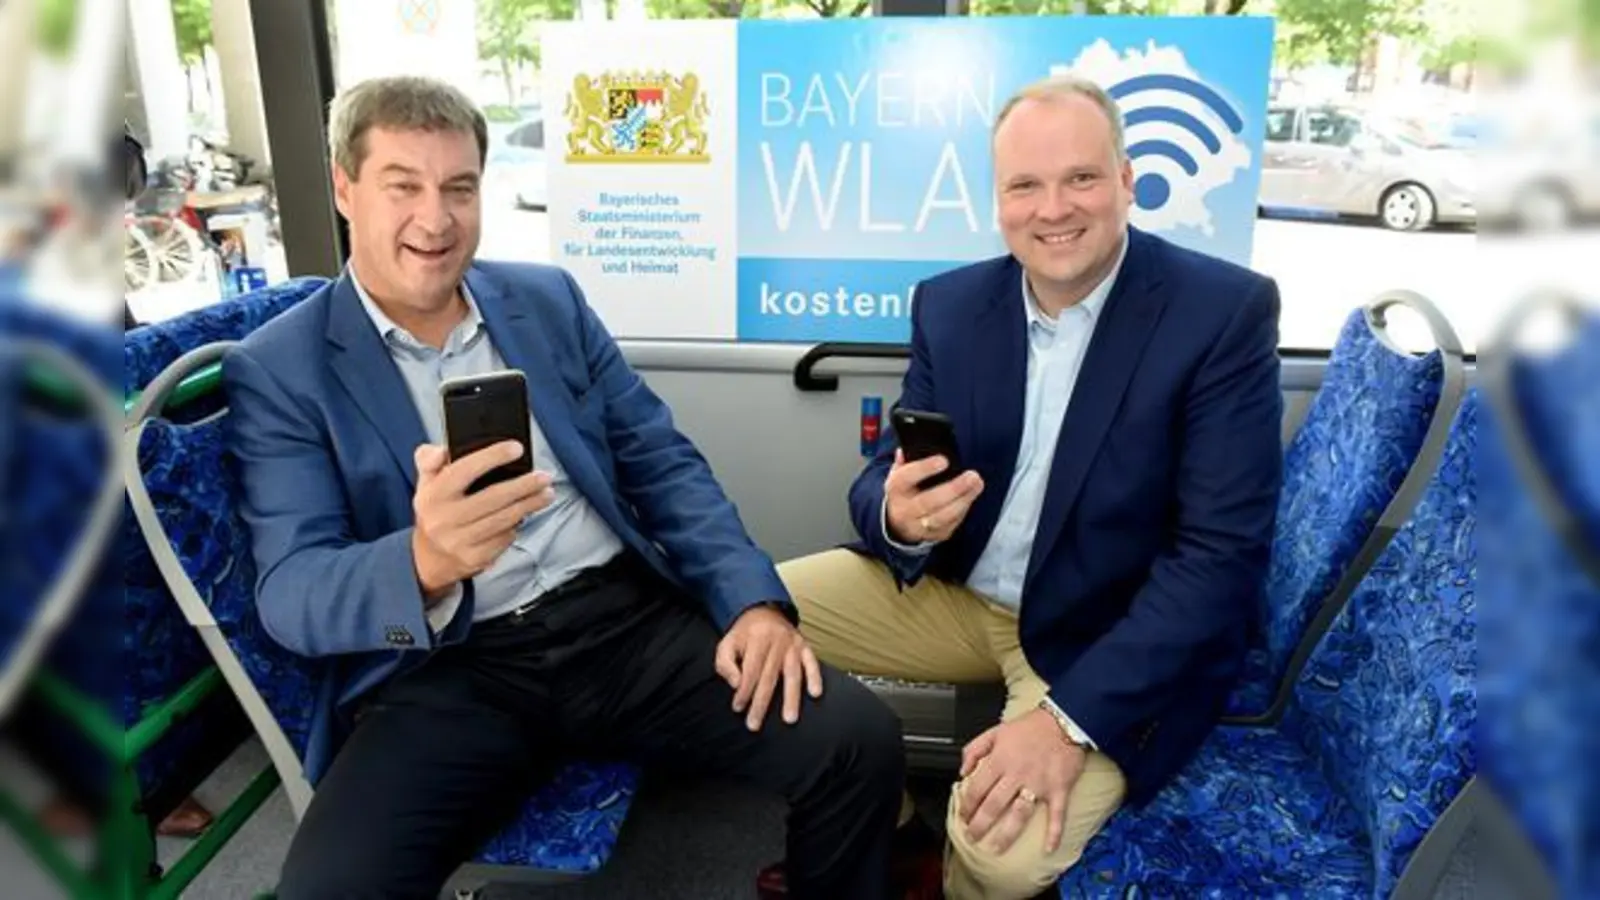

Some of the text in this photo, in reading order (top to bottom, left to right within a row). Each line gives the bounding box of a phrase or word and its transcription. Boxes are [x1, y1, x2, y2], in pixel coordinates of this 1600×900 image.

[760, 72, 996, 127] BAYERN
[759, 140, 1001, 232] WLA
[599, 192, 680, 207] Bayerisches
[577, 209, 702, 223] Staatsministerium
[594, 227, 618, 239] der
[564, 242, 717, 261] für Landesentwicklung
[601, 260, 680, 275] und Heimat
[760, 282, 914, 317] kostenl
